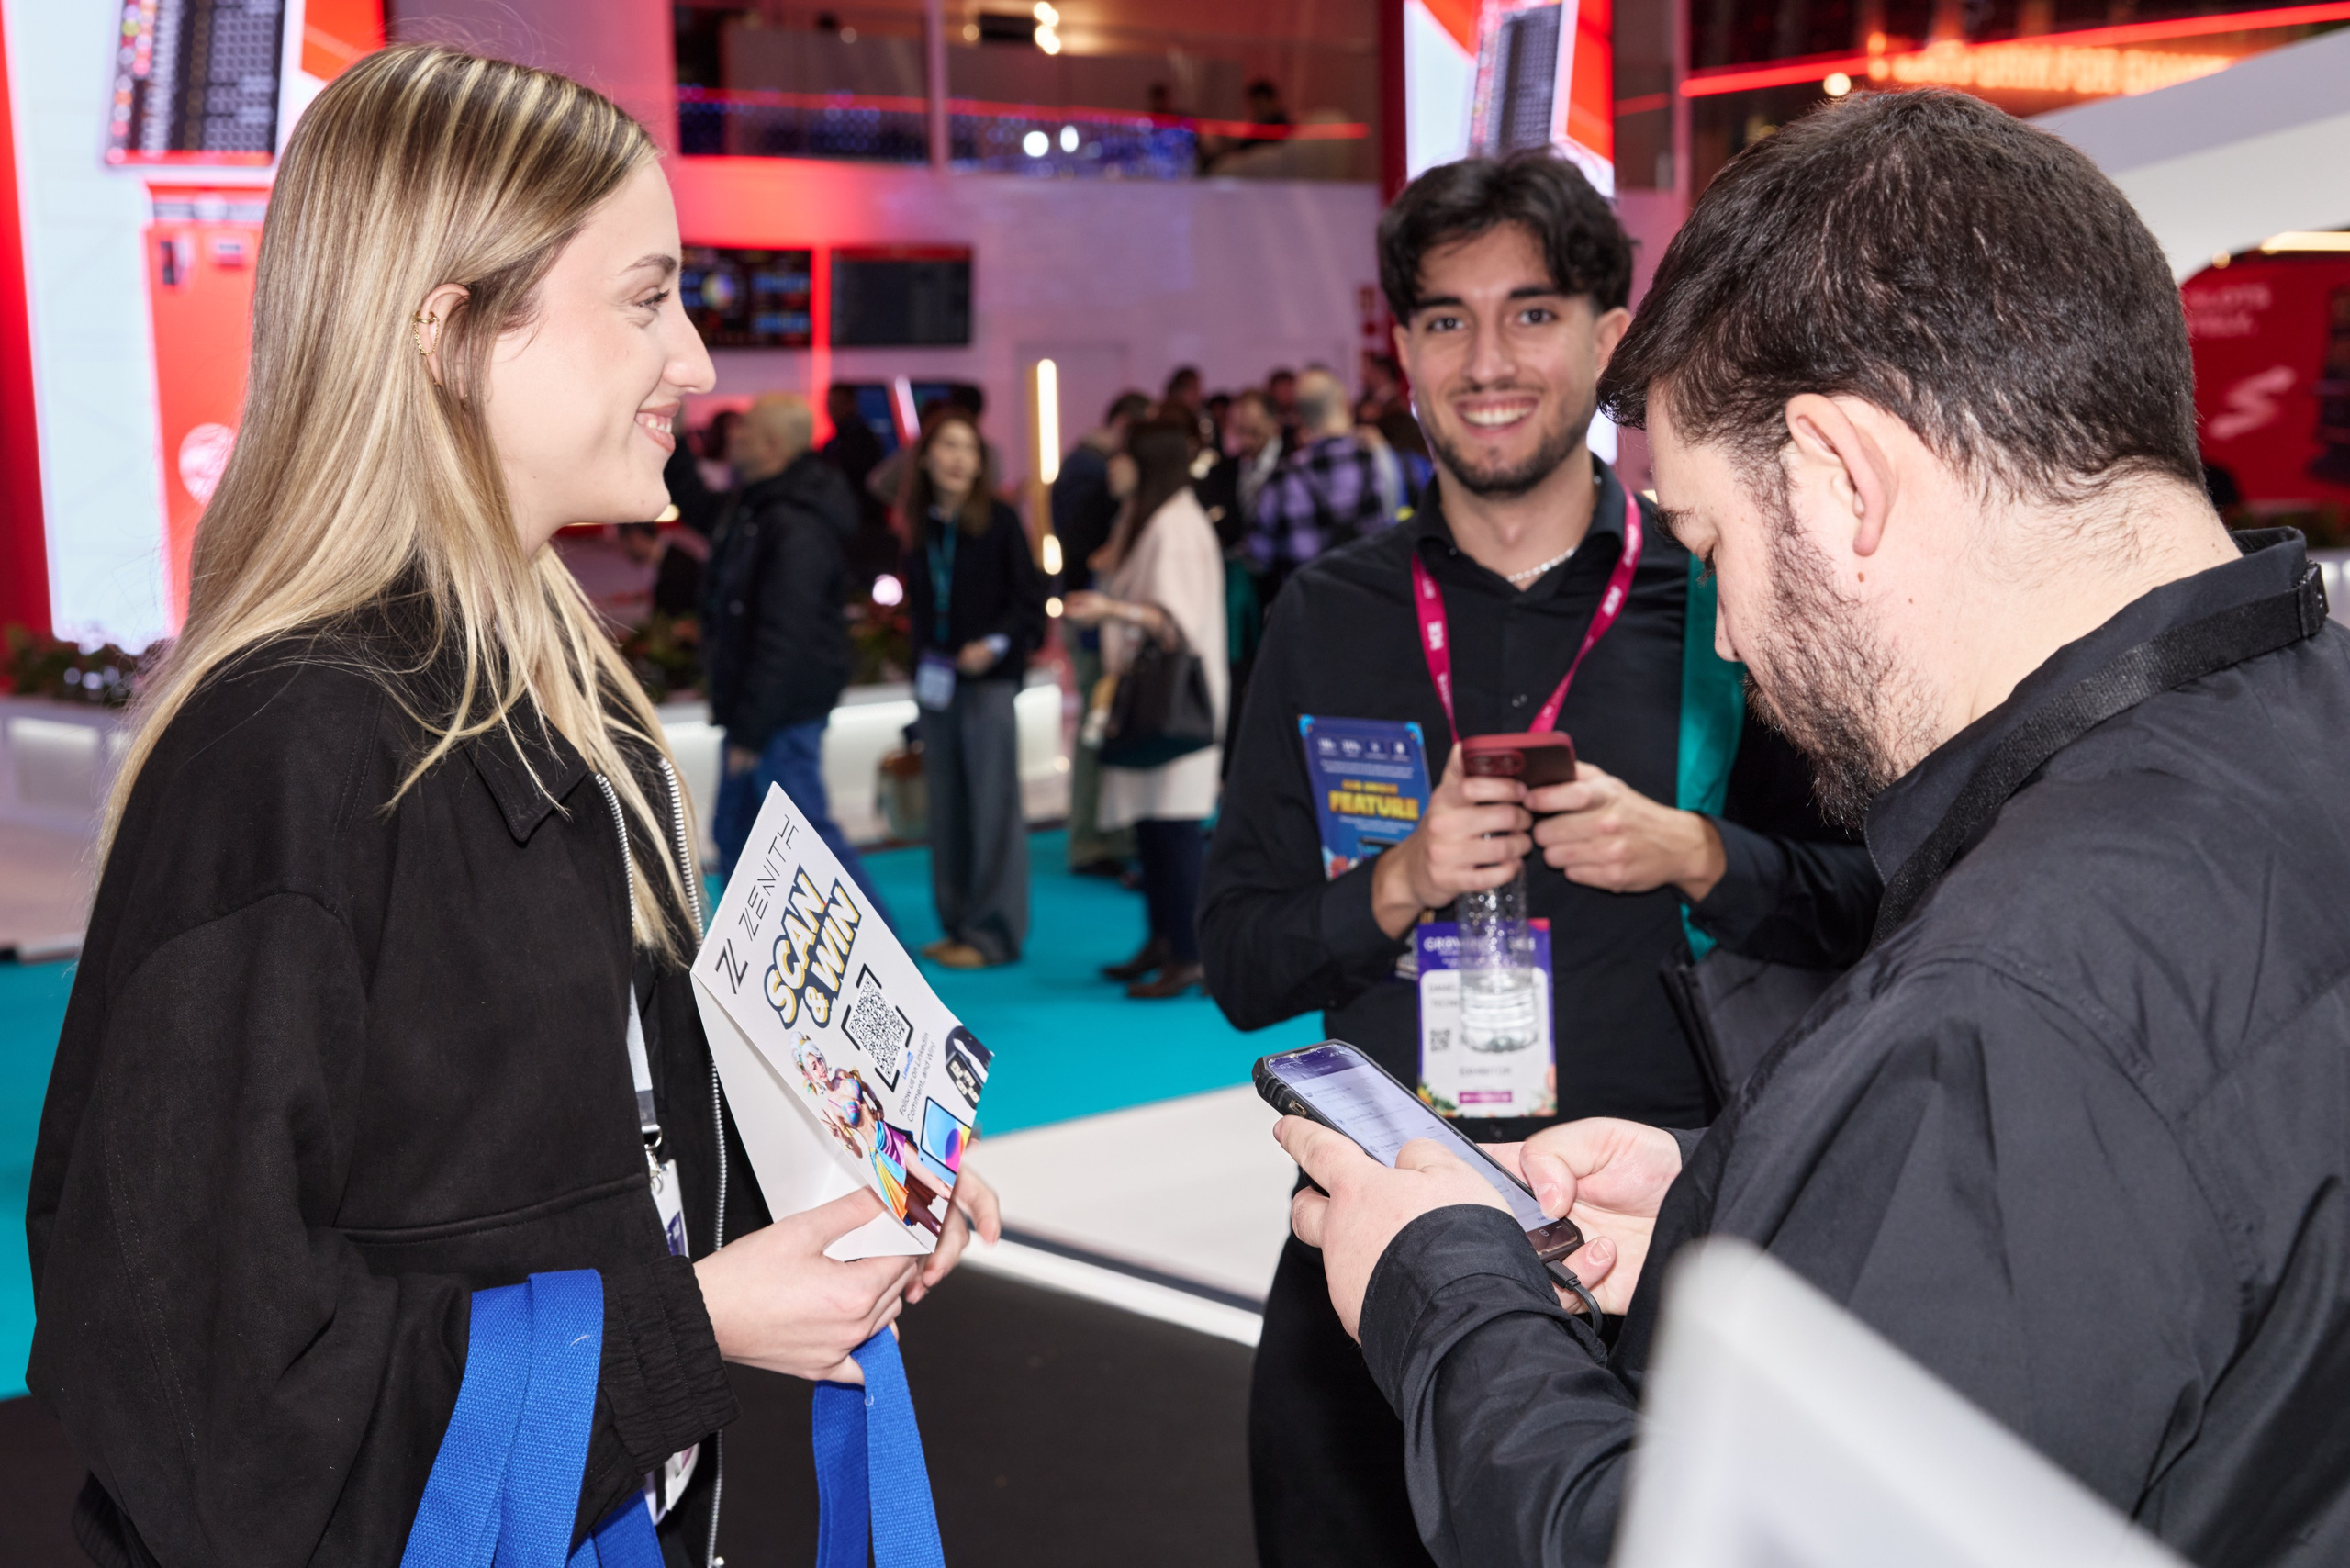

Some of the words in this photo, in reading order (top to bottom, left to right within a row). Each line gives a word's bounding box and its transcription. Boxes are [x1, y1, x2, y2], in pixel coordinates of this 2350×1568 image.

[1328, 790, 1419, 821] FEATURE
[738, 813, 800, 942] ZENITH
[765, 867, 826, 1026] SCAN
[810, 881, 861, 995] WIN
[803, 984, 830, 1025] &
[914, 1032, 930, 1067] LinkedIn
[926, 1040, 936, 1061] Win!
[909, 1077, 915, 1090] us
[912, 1066, 918, 1079] on
[922, 1059, 931, 1079] and
[899, 1088, 912, 1116] Follow
